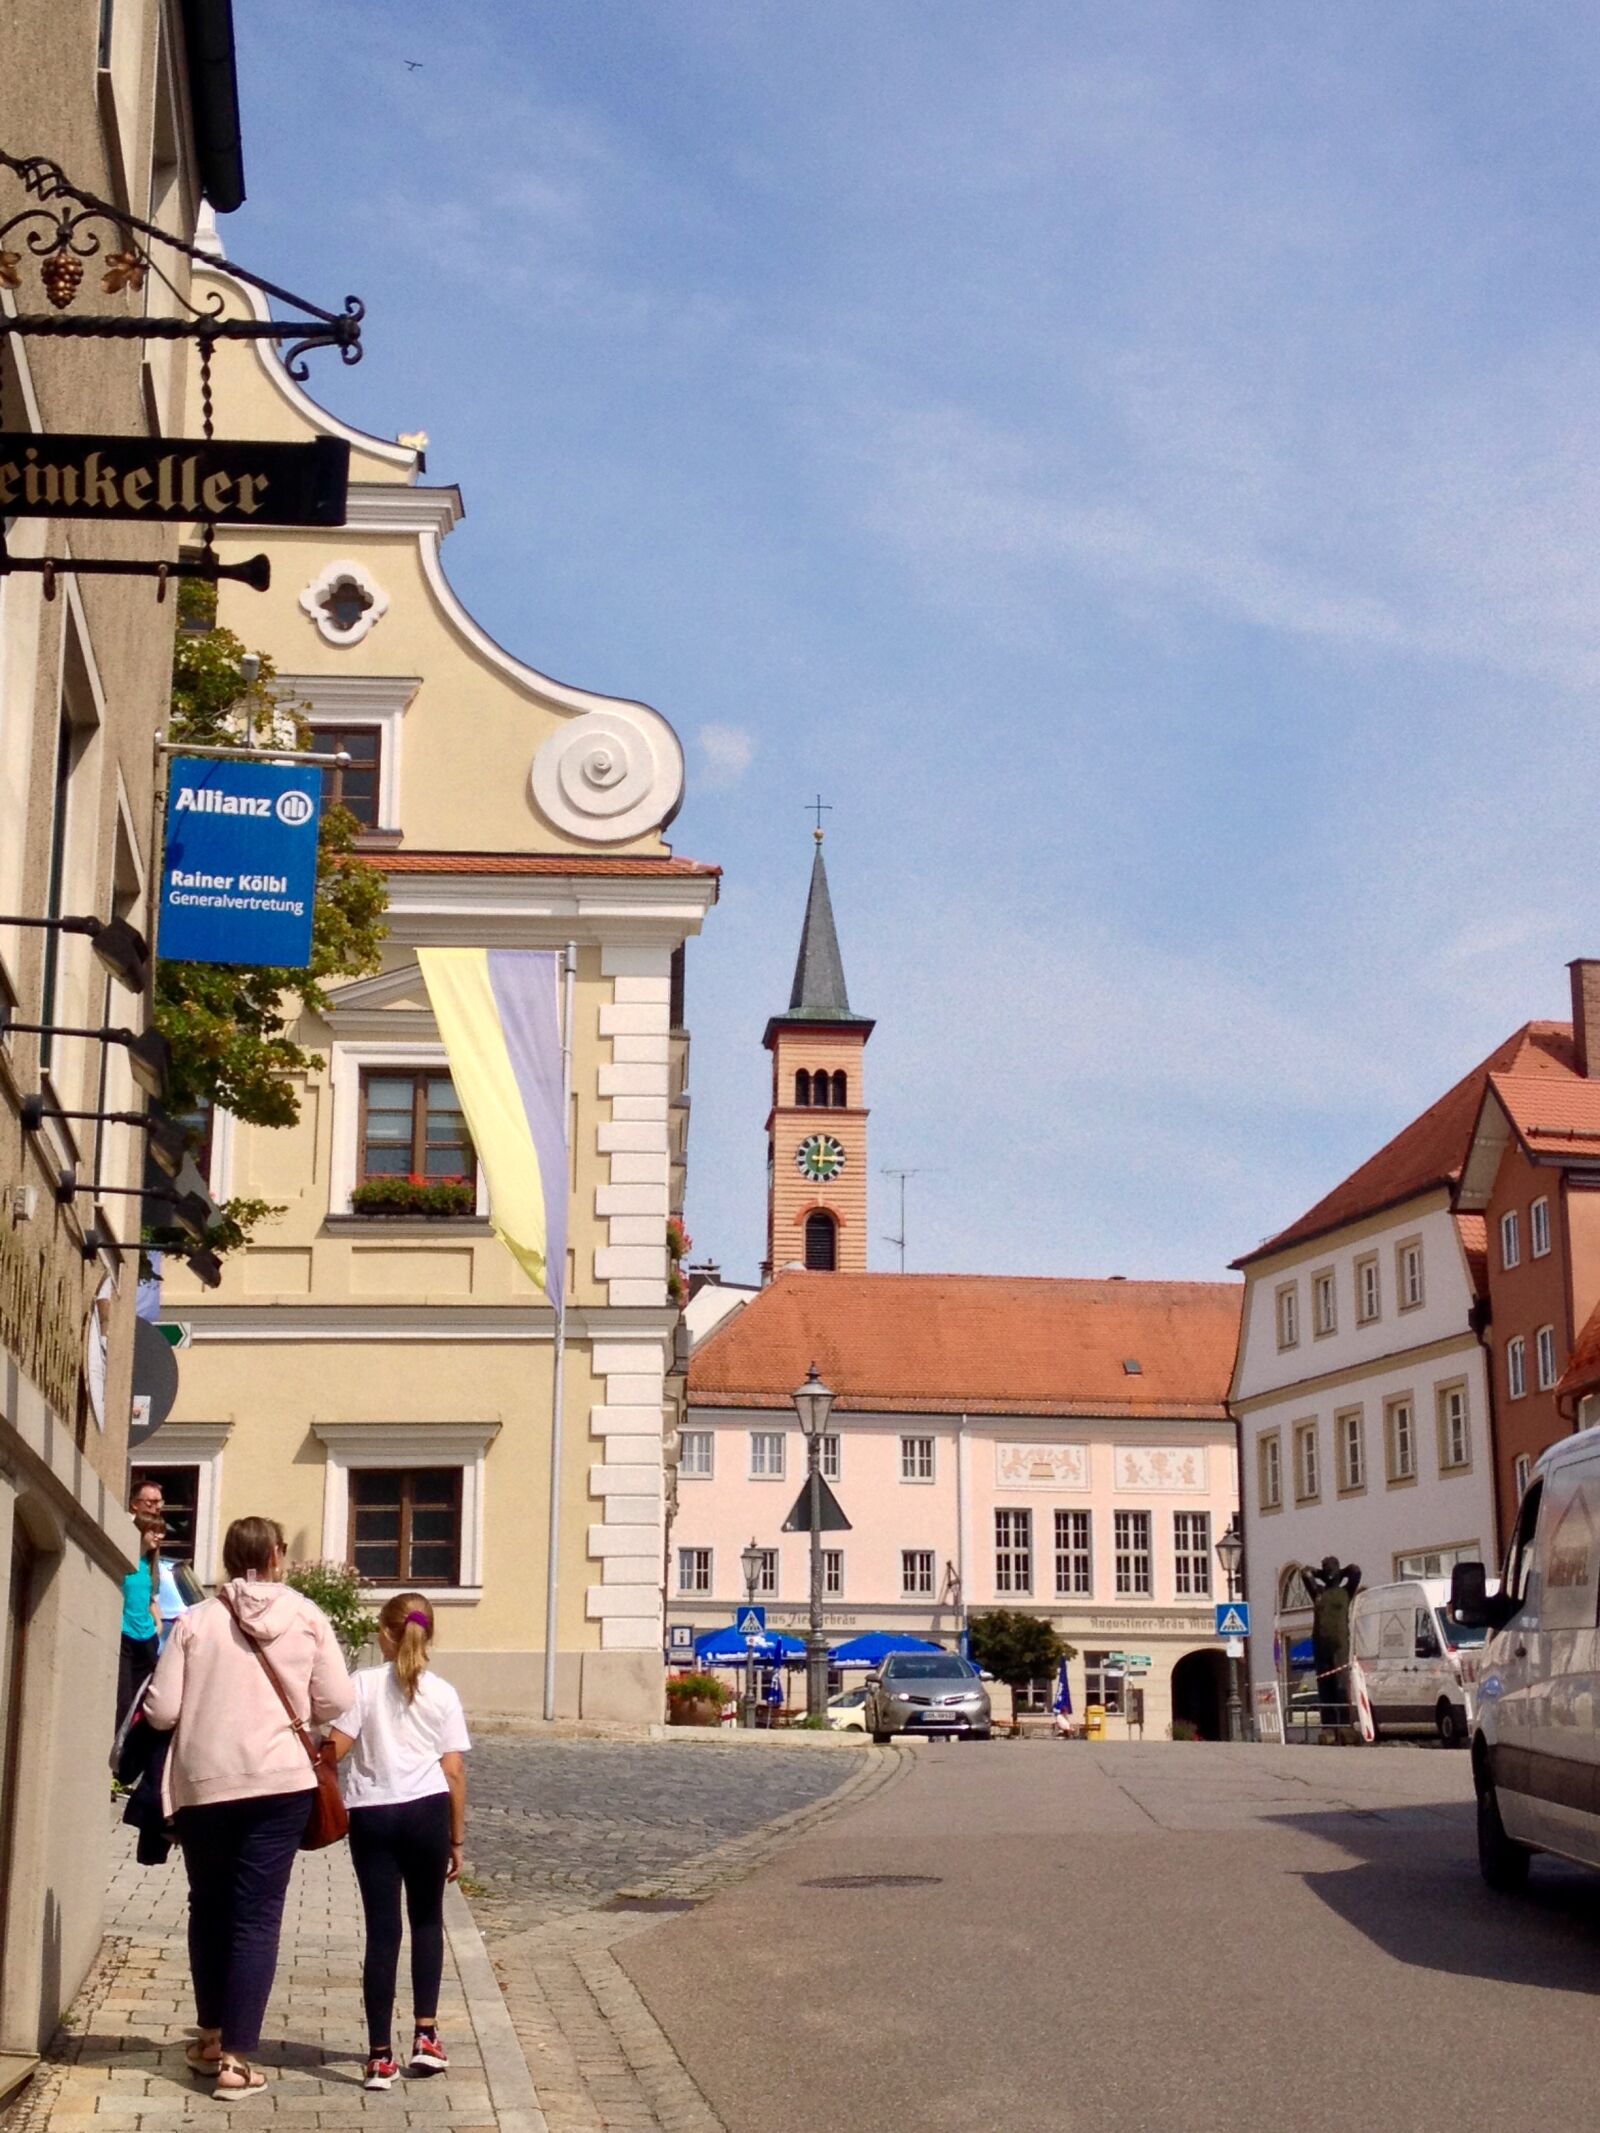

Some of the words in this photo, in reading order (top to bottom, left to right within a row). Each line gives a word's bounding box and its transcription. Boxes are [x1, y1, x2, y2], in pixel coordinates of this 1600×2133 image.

[175, 787, 272, 817] Allianz
[171, 870, 234, 890] Rainer
[238, 874, 287, 893] Kölbl
[169, 890, 304, 916] Generalvertretung
